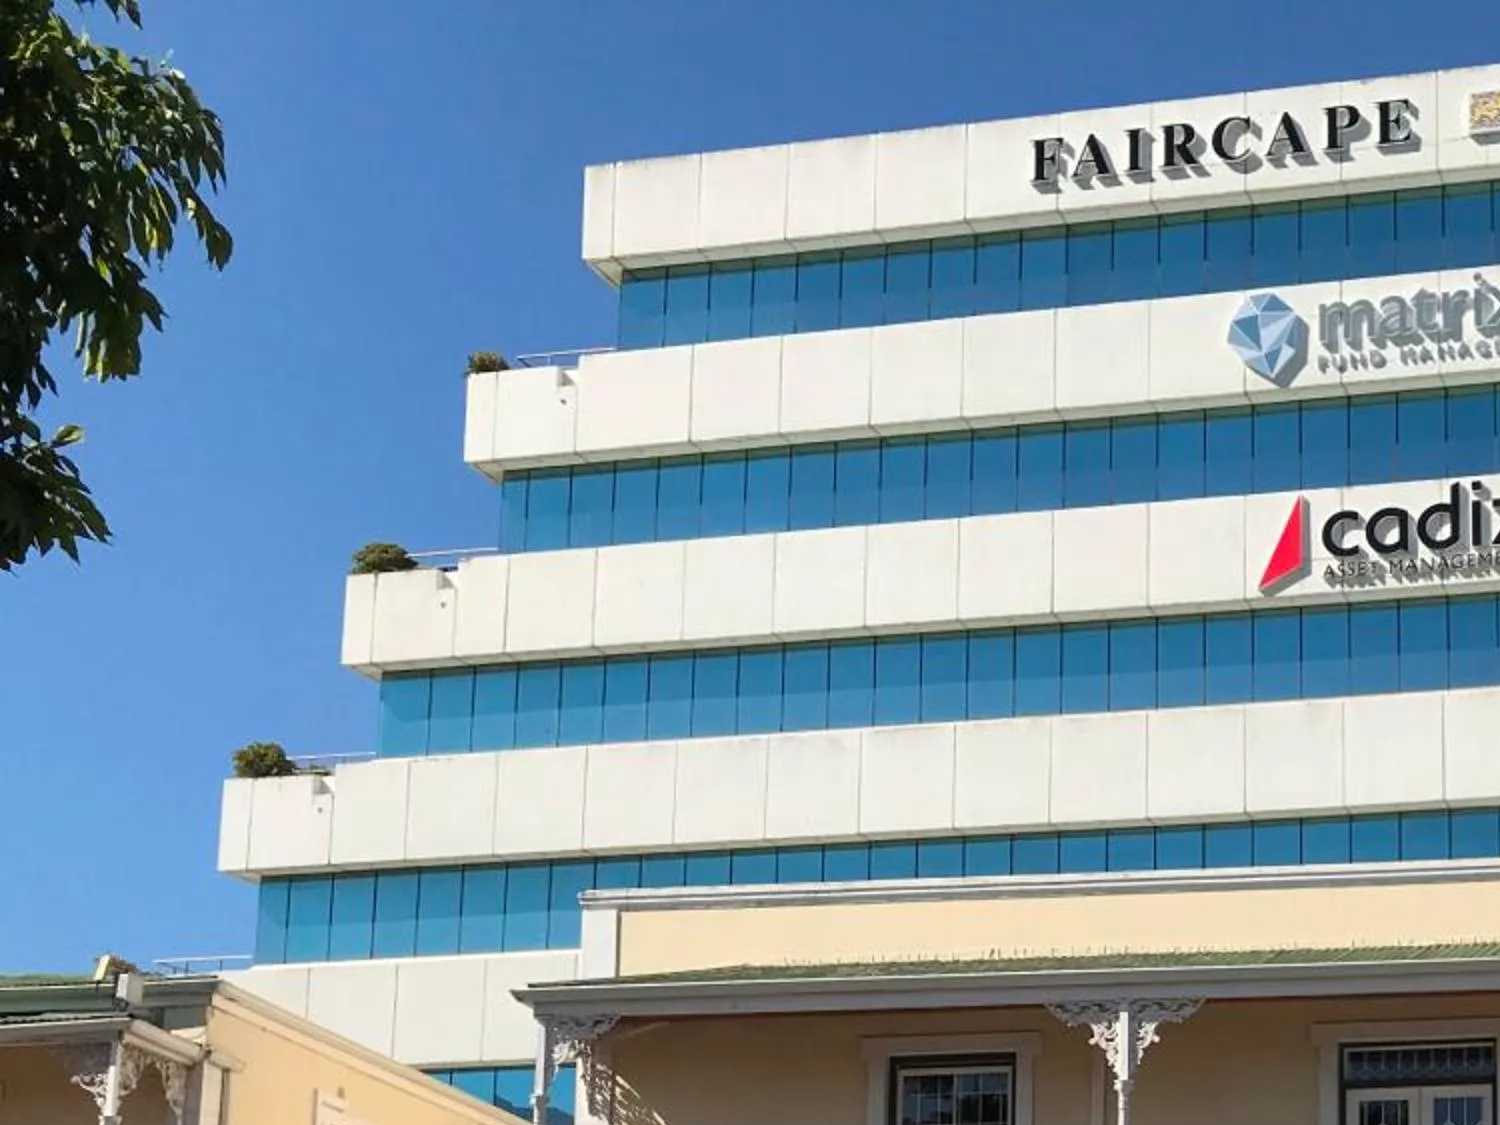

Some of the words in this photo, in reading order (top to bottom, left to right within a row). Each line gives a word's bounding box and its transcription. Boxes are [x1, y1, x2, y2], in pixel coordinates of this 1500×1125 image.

[1031, 98, 1413, 182] FAIRCAPE
[1317, 350, 1387, 374] FUND
[1323, 560, 1378, 579] ASSET
